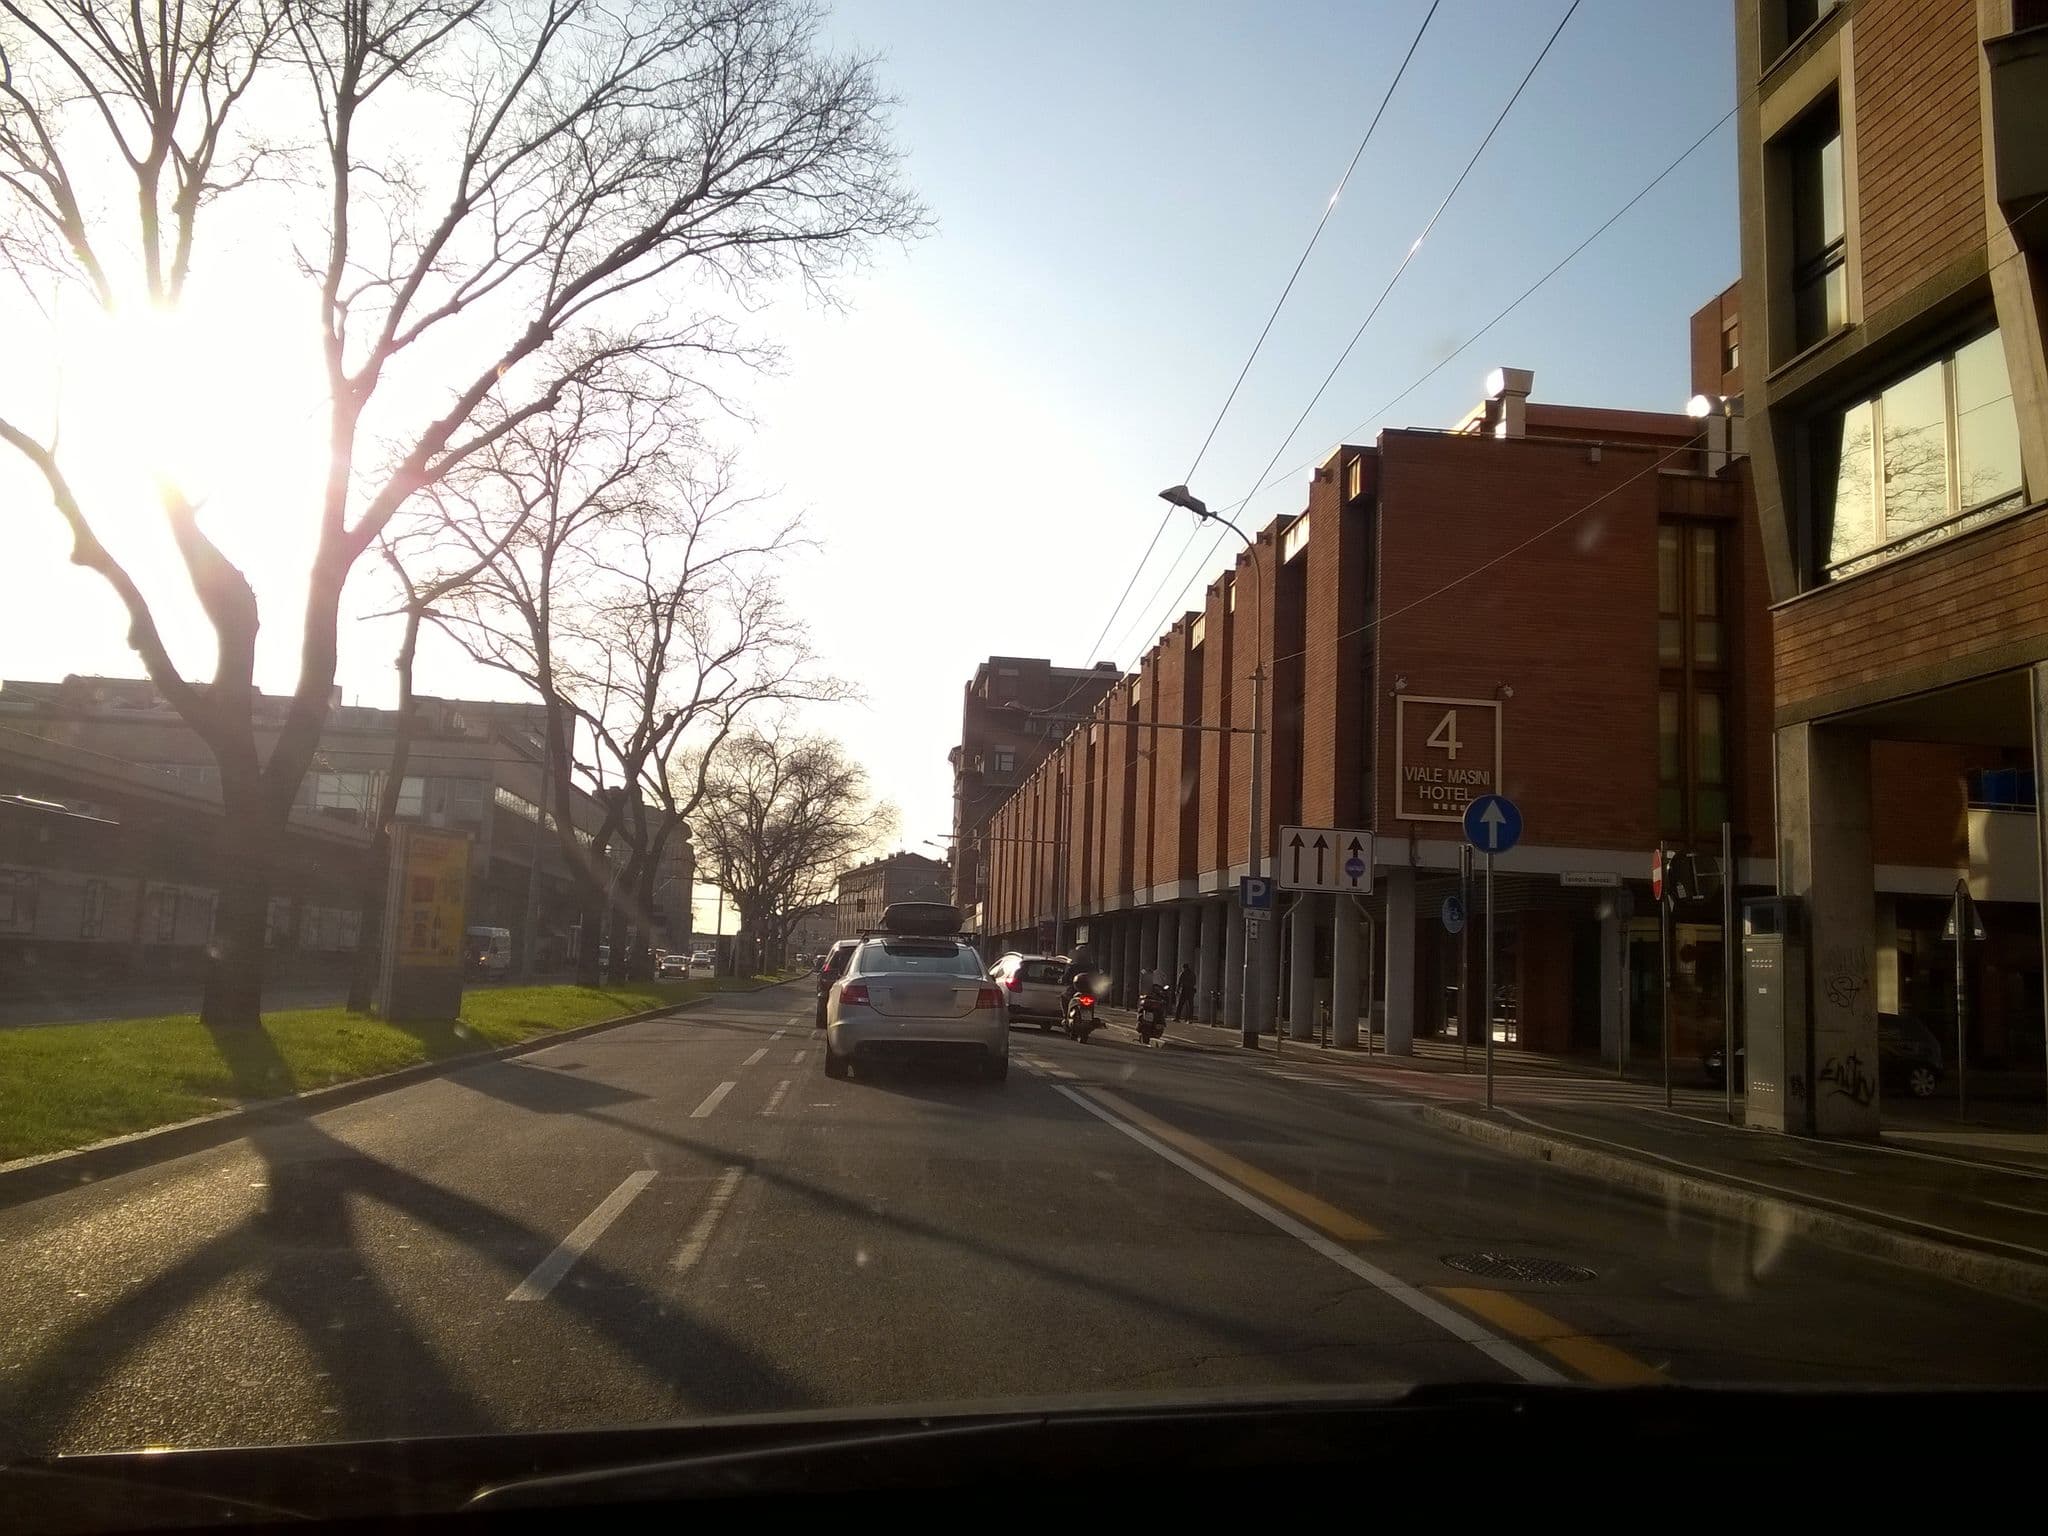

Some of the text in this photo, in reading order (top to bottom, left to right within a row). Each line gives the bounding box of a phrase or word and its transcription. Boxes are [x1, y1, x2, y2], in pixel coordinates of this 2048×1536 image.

[1426, 709, 1463, 760] 4
[1404, 766, 1490, 785] VIALE MASINI
[1419, 786, 1475, 801] HOTEL
[1247, 880, 1266, 905] P
